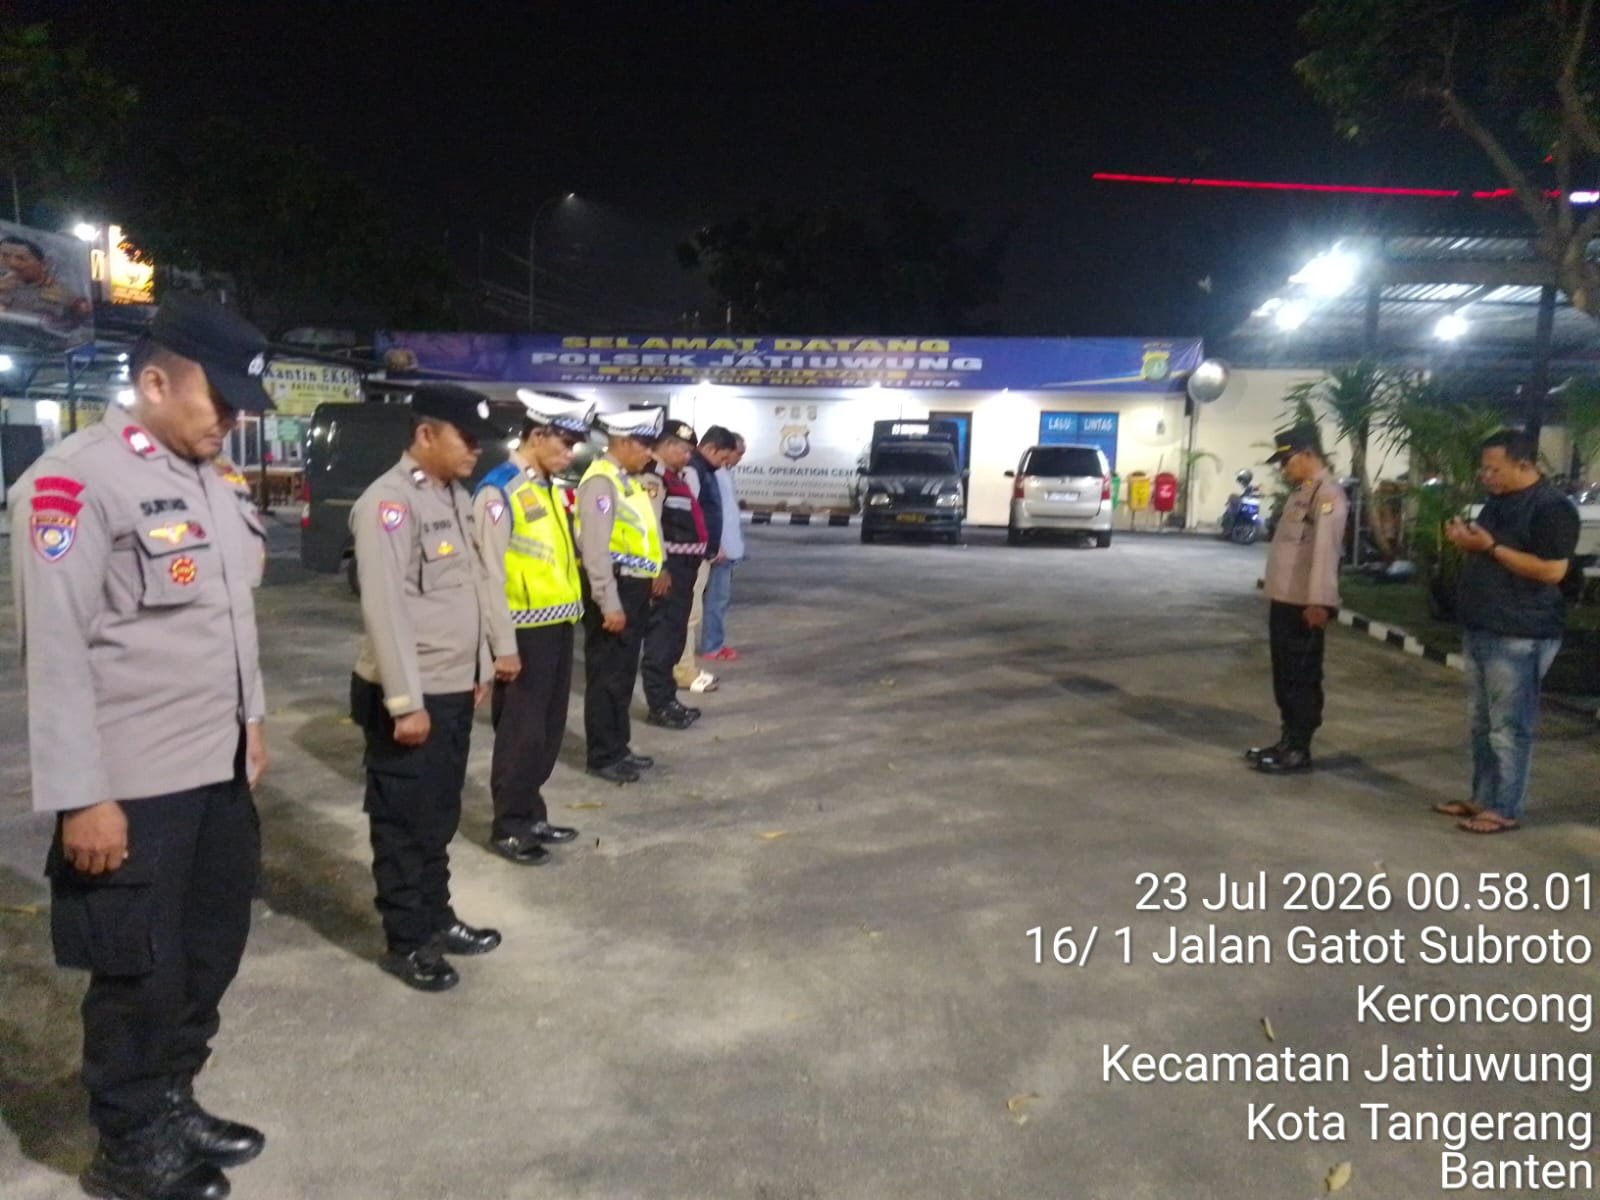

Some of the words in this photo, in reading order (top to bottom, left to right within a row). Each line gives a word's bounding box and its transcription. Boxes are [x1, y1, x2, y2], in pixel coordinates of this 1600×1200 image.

[562, 336, 762, 350] SELAMAT
[775, 338, 949, 352] DATANG
[532, 352, 696, 366] POLSEK
[709, 354, 983, 371] JATIUWUNG
[1048, 417, 1072, 430] LALU
[1084, 418, 1113, 431] LINTAS
[769, 466, 829, 477] OPERATION
